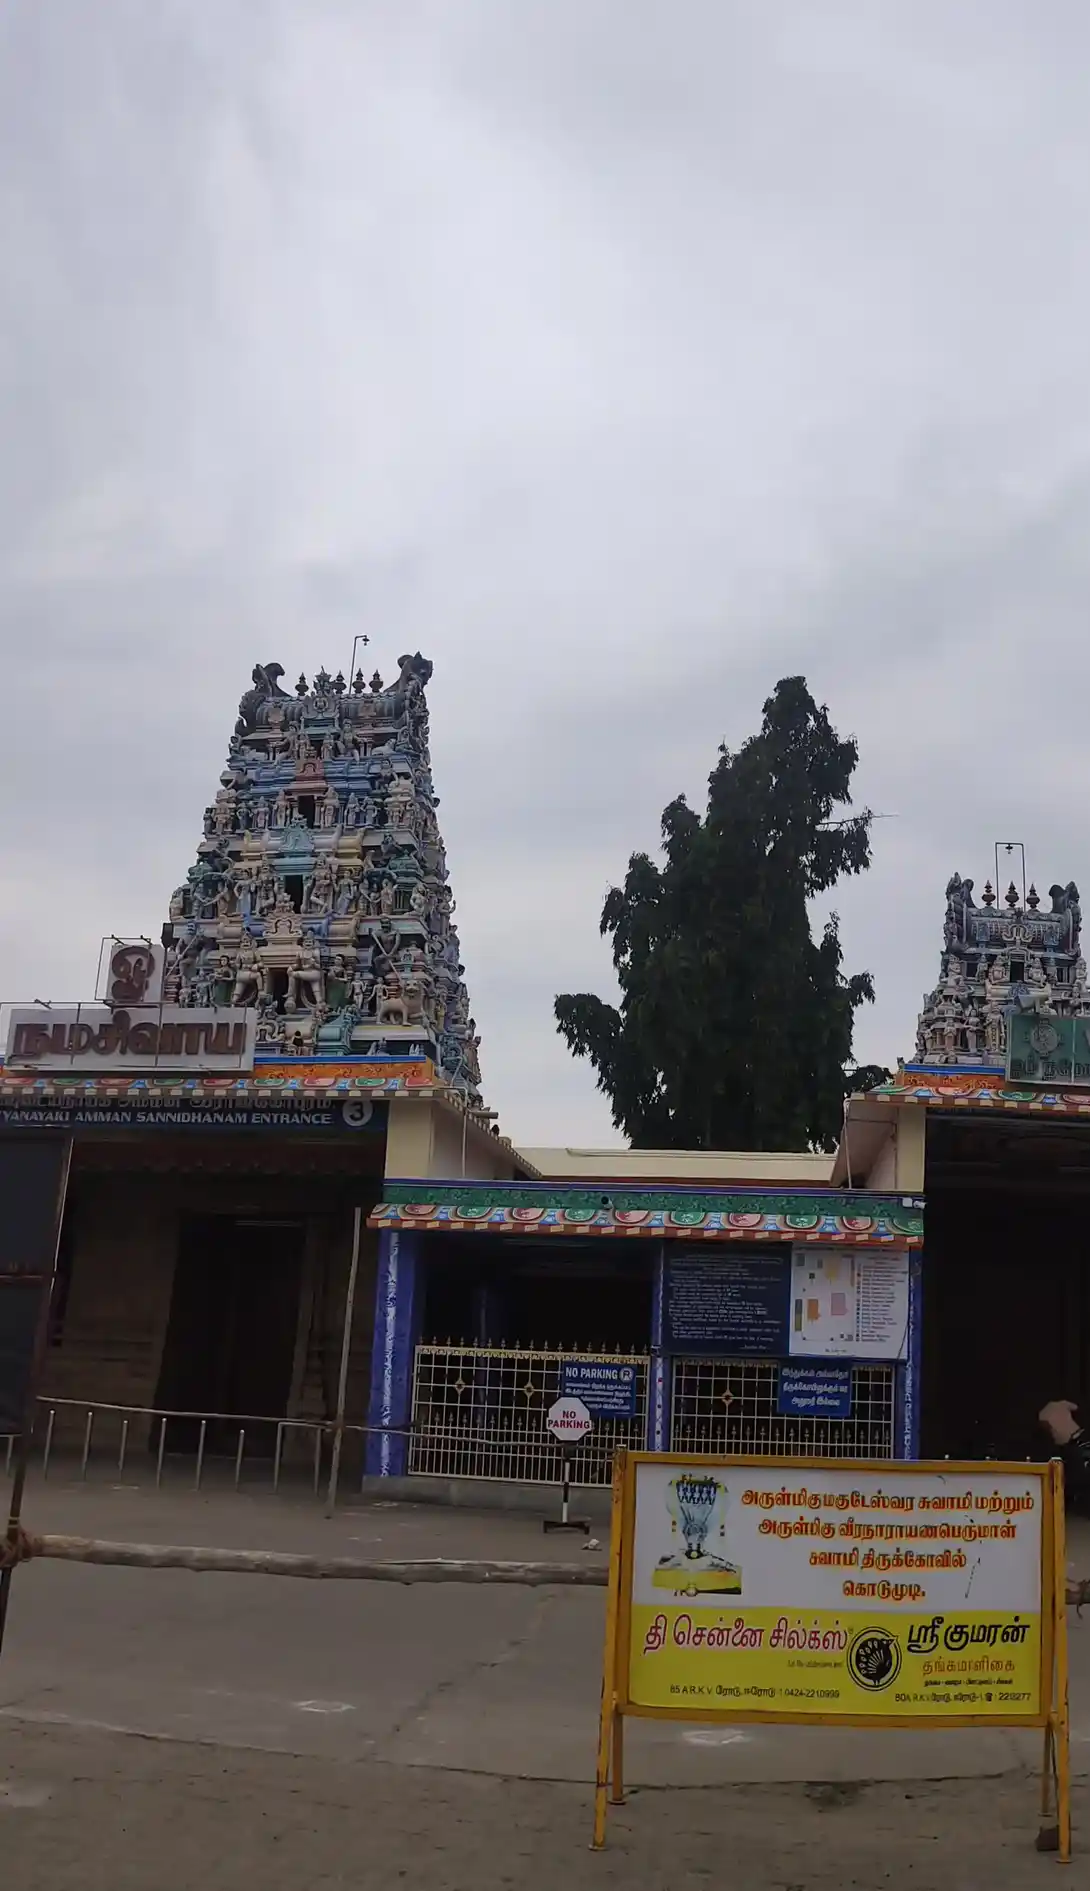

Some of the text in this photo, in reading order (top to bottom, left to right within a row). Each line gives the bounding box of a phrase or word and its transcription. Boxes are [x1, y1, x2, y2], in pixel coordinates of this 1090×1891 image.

[9, 1010, 248, 1063] நமசிவாய
[0, 1109, 332, 1125] YANAYAKI AMMAN SANNIDHANAM ENTRANCE
[565, 1367, 619, 1380] NO PARKING
[547, 1419, 591, 1430] PARKING
[562, 1410, 577, 1419] NO
[741, 1486, 822, 1510] அருள்மிகு
[917, 1490, 973, 1510] சுவாமி
[974, 1490, 1035, 1515] மற்றும்
[758, 1515, 836, 1539] அருள்மிகு
[860, 1547, 967, 1571] திருக்கோவில்
[642, 1613, 848, 1655] தி சென்னை சில்க்ஸ்
[922, 1655, 1015, 1677] தங்கமாளிகை
